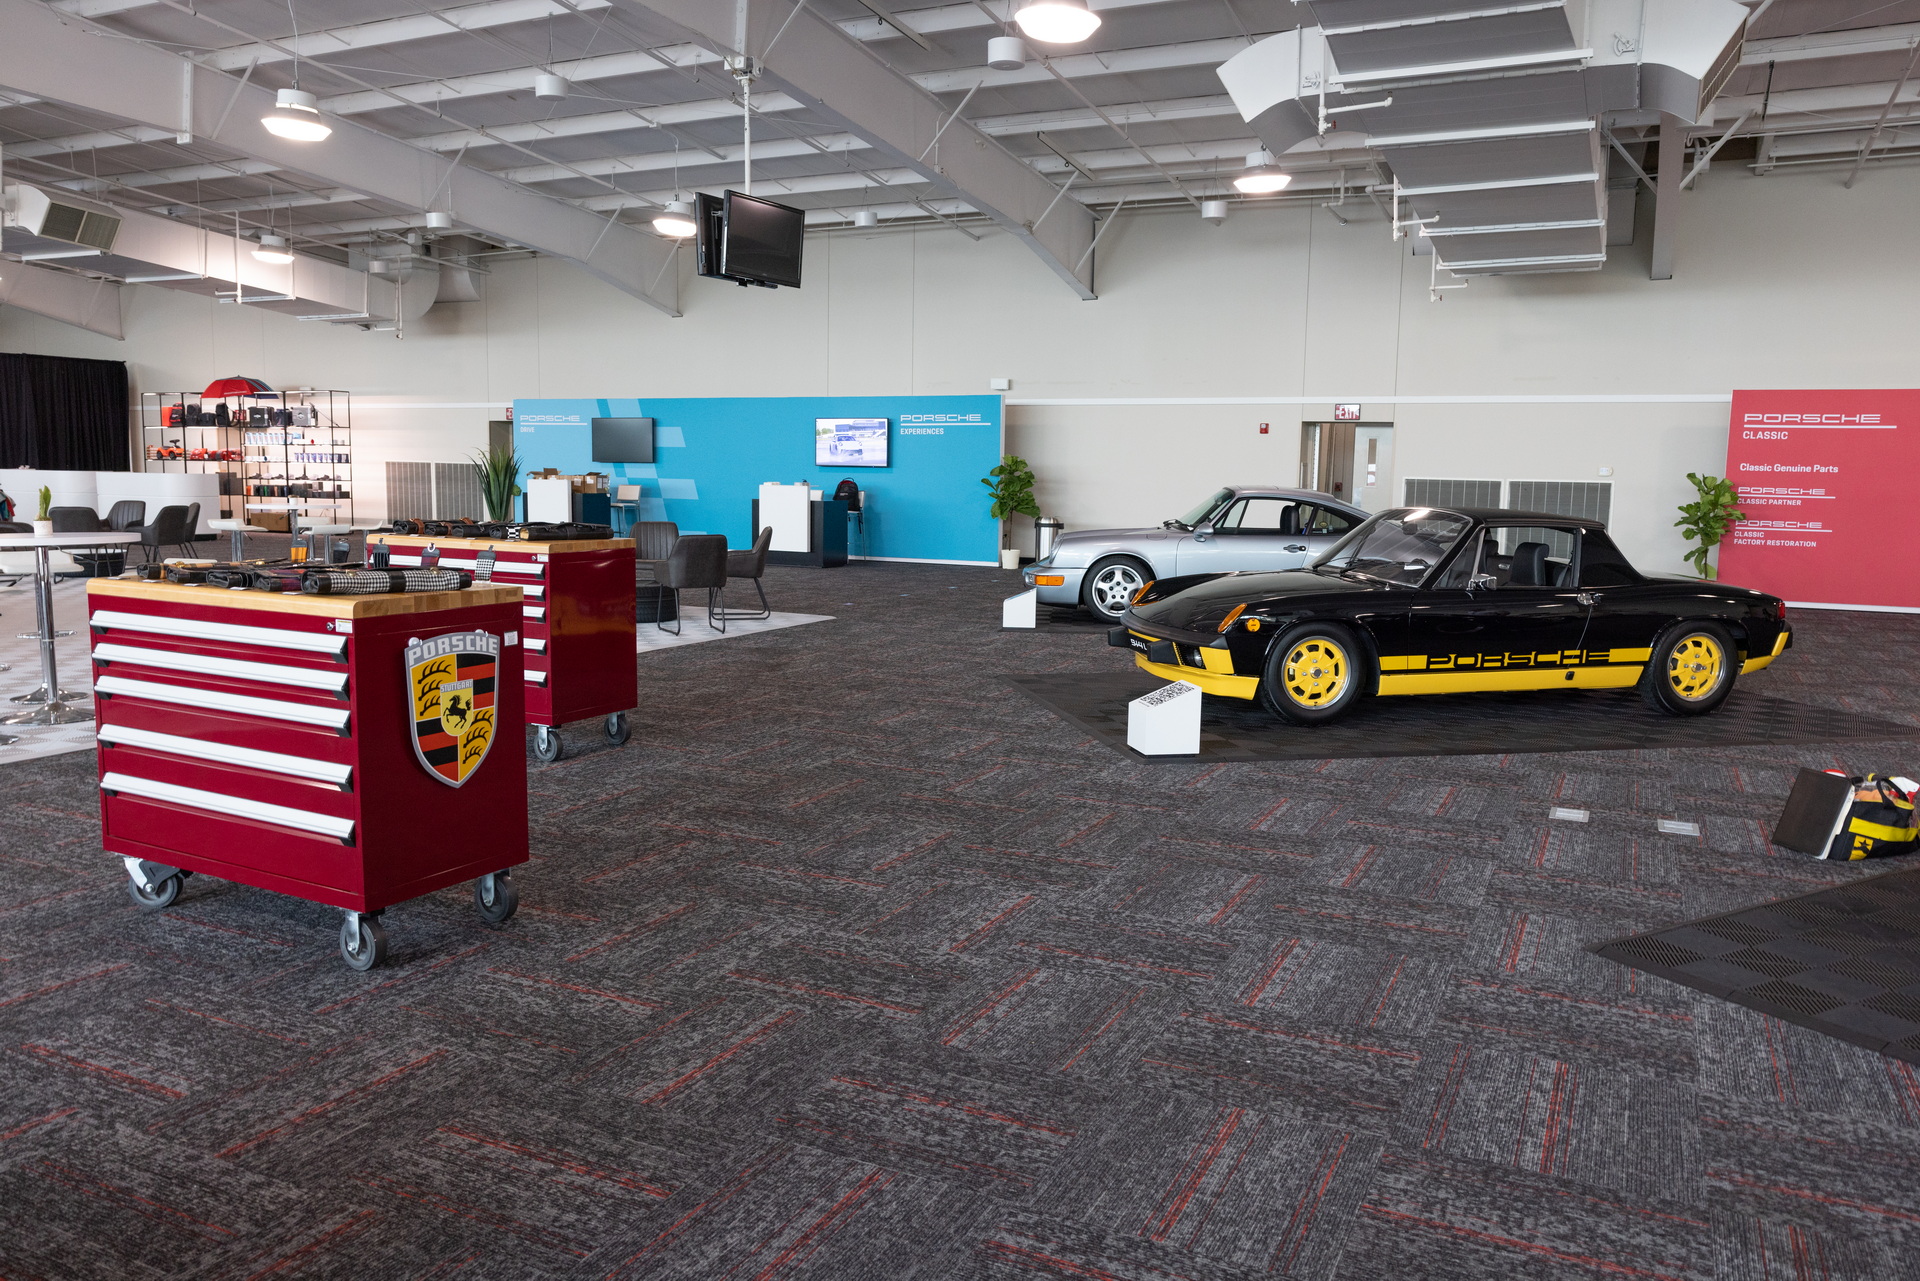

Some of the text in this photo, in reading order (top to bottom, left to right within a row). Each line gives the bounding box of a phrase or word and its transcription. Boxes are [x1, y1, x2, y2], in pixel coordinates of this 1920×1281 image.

[900, 414, 981, 422] PORSCHE
[1743, 413, 1881, 423] PORSCHE
[1742, 431, 1789, 440] CLASSIC
[1739, 463, 1839, 473] Classic Genuine Parts
[1738, 487, 1826, 495] PORSCHE
[1768, 498, 1802, 506] PARTNER
[1735, 520, 1822, 528] PORSCHE
[1733, 538, 1817, 547] FACTORY RESTORATION
[408, 635, 498, 667] PORSCHE
[1427, 649, 1611, 669] PORSCHE
[440, 681, 472, 692] STUTTGART
